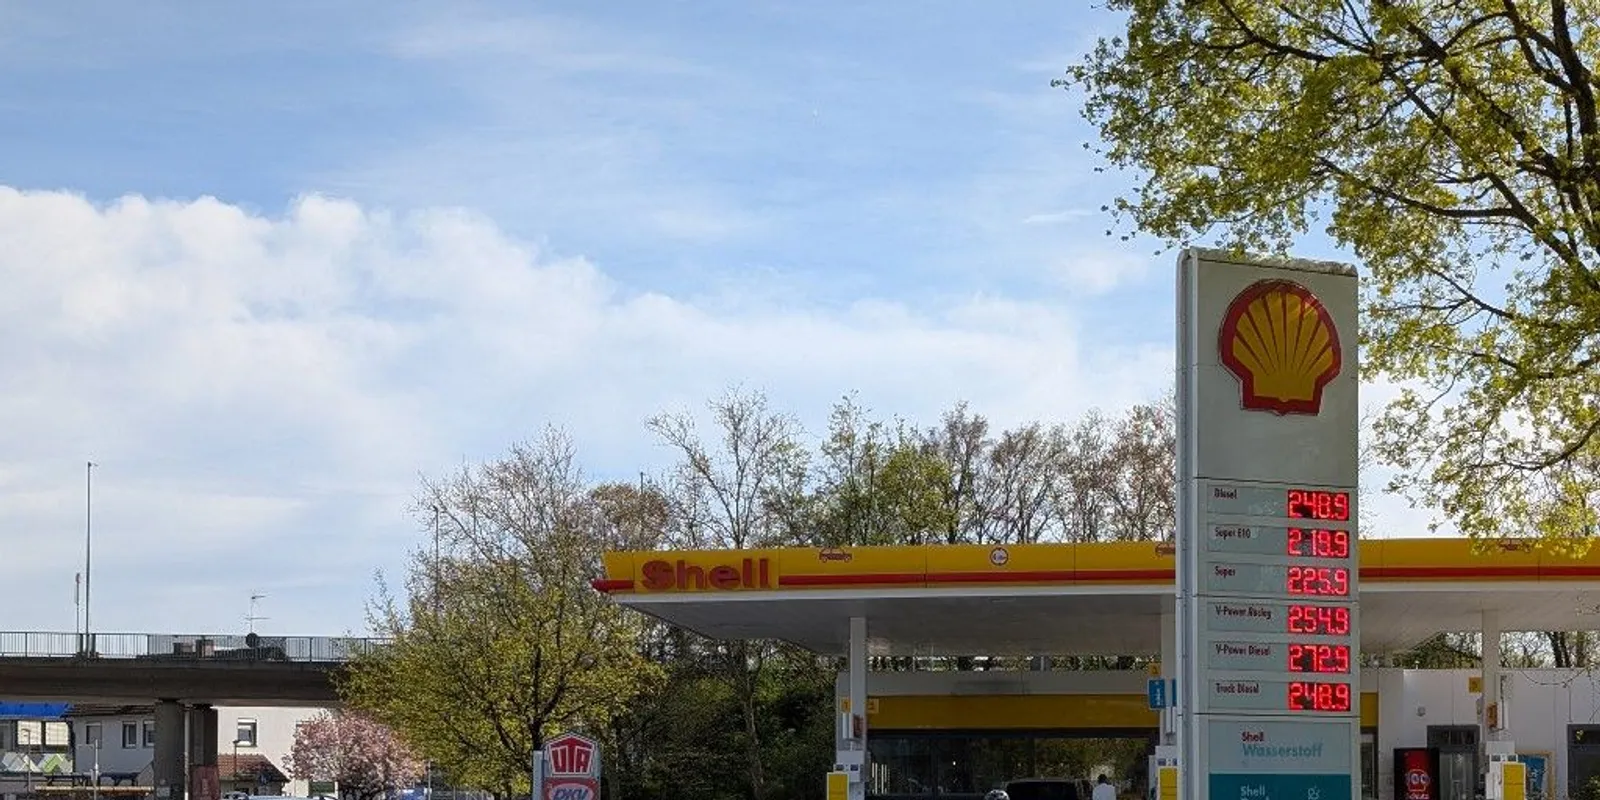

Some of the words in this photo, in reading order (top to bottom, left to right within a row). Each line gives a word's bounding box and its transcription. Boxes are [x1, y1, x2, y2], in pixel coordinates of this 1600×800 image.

[1214, 488, 1237, 499] Diesel
[1288, 491, 1348, 520] 248.9
[1214, 527, 1236, 540] Super
[1237, 528, 1251, 538] E10
[1288, 529, 1348, 557] 219.9
[641, 558, 771, 590] Shell
[1214, 566, 1236, 578] Super
[1288, 567, 1348, 595] 225.9
[1214, 605, 1246, 616] V-Power
[1288, 606, 1349, 634] 254.9
[1214, 644, 1246, 654] V-Power
[1248, 646, 1270, 656] Diesel
[1288, 645, 1349, 672] 272.9
[1216, 683, 1235, 693] Truck
[1237, 683, 1259, 694] Diesel
[1288, 683, 1349, 710] 248.9
[1241, 732, 1264, 741] Shell
[551, 738, 592, 773] UTA
[1242, 743, 1322, 757] Wasserstoff
[1240, 785, 1265, 796] Shell
